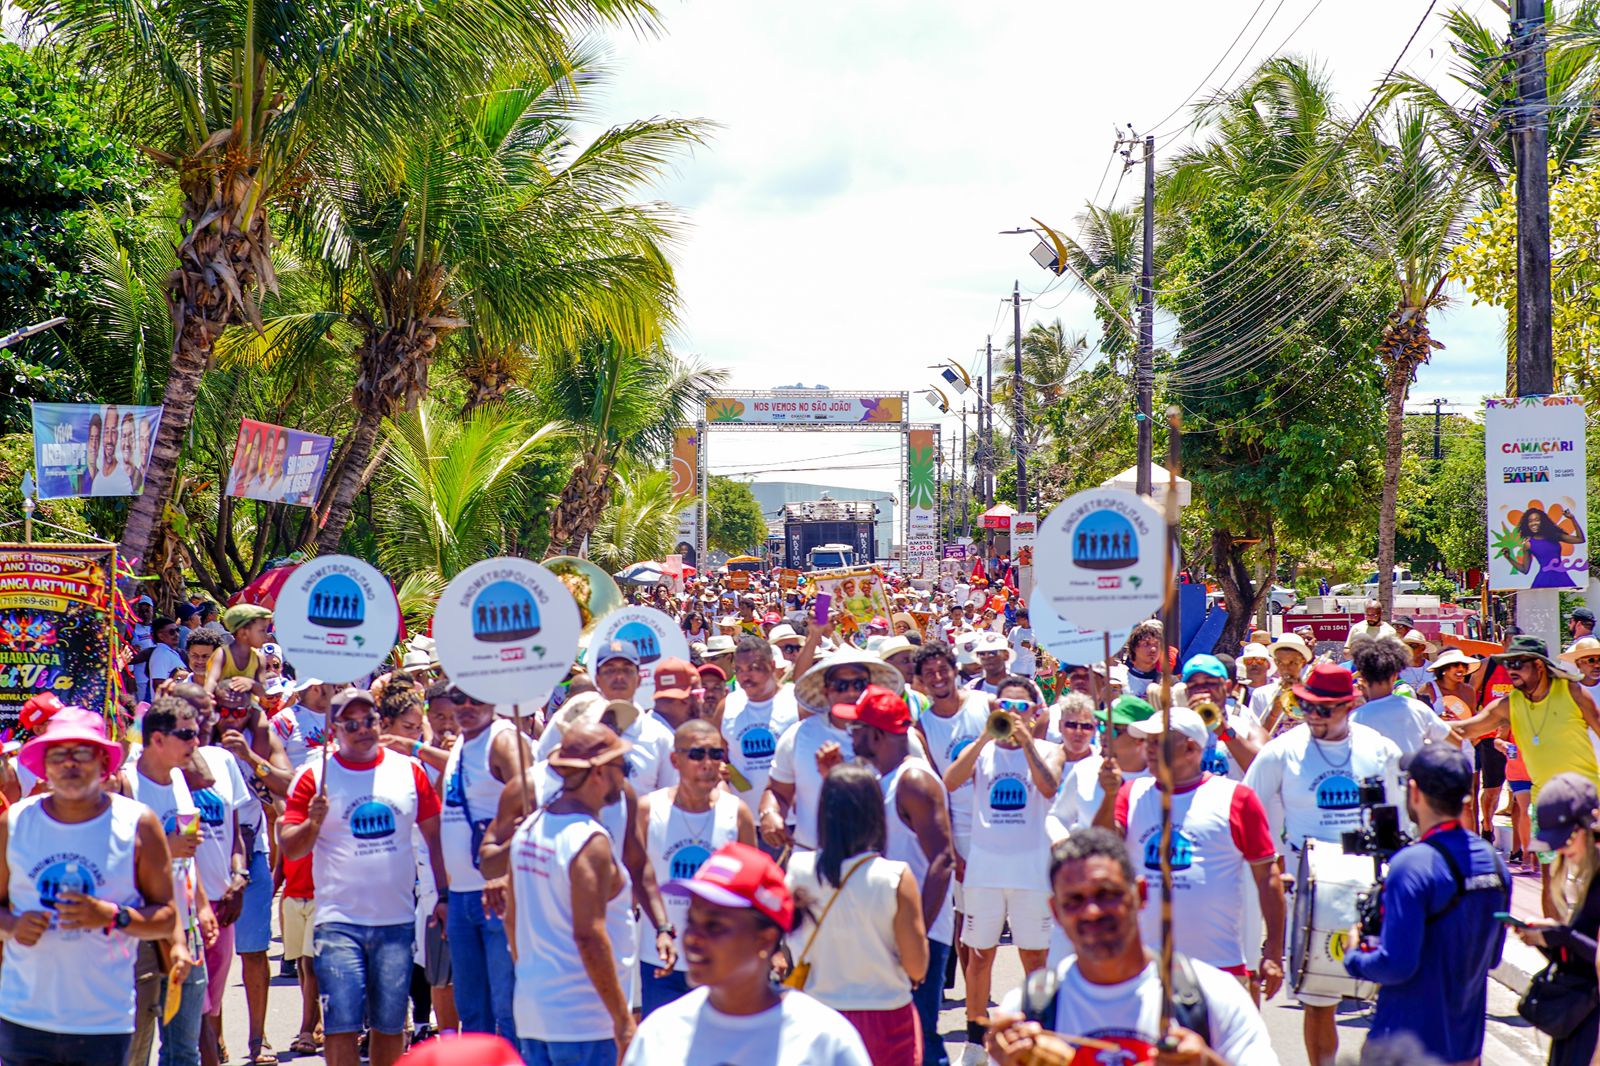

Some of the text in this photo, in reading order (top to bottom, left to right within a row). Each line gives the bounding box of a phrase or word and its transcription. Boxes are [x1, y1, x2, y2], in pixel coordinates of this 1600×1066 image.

[754, 400, 851, 411] NOS VEMOS NO SÃO JOÃO!
[1501, 441, 1573, 454] CAMAÇARI
[1504, 471, 1550, 483] BAHIA
[4, 563, 60, 573] ANO TODO
